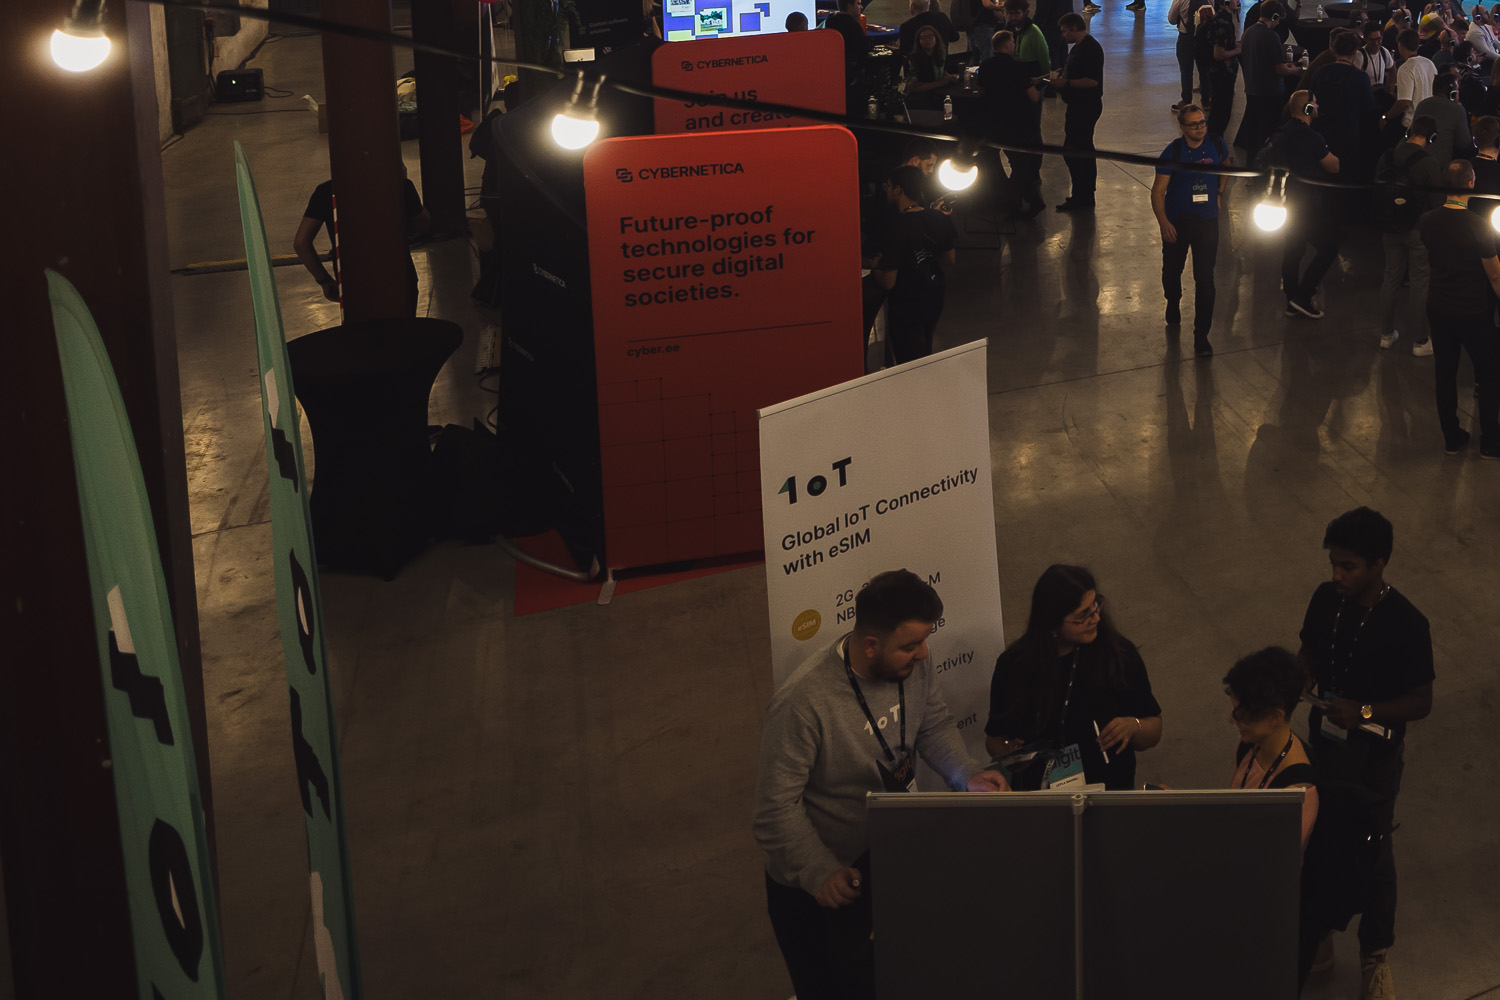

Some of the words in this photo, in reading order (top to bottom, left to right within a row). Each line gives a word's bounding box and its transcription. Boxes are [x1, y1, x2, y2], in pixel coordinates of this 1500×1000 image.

[697, 55, 768, 70] CYBERNETICA
[685, 112, 723, 130] and
[638, 163, 744, 180] CYBERNETICA
[620, 205, 773, 234] Future-proof
[621, 231, 777, 259] technologies
[783, 228, 815, 246] for
[623, 263, 705, 283] secure
[712, 253, 784, 278] digital
[624, 283, 740, 307] societies.
[627, 344, 680, 359] cyber.ee
[781, 516, 840, 551] Global
[844, 505, 870, 527] IoT
[875, 467, 978, 516] Connectivity
[782, 549, 824, 576] with
[828, 528, 871, 560] eSIM
[797, 617, 817, 633] eSIM
